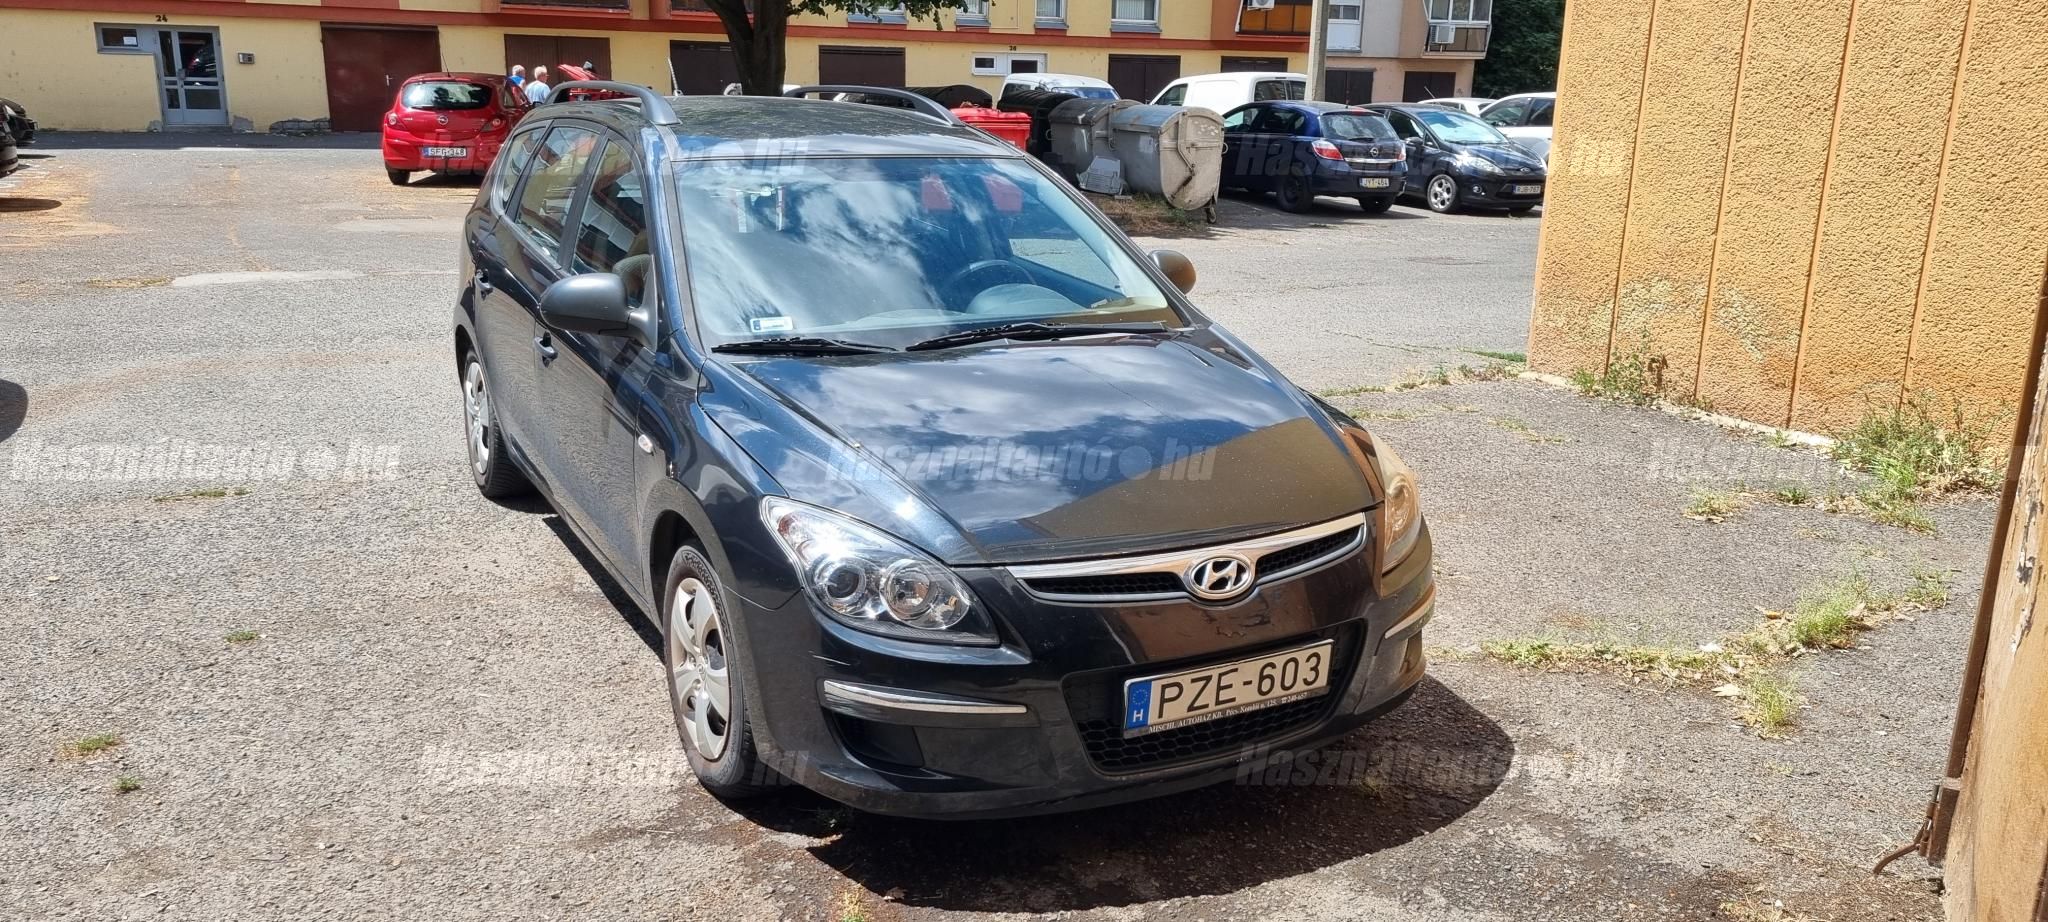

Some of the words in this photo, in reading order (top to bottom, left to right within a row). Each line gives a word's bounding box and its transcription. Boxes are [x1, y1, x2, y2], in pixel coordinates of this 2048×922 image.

[156, 14, 168, 22] 24
[1157, 651, 1322, 719] PZE-603
[1132, 708, 1144, 722] H
